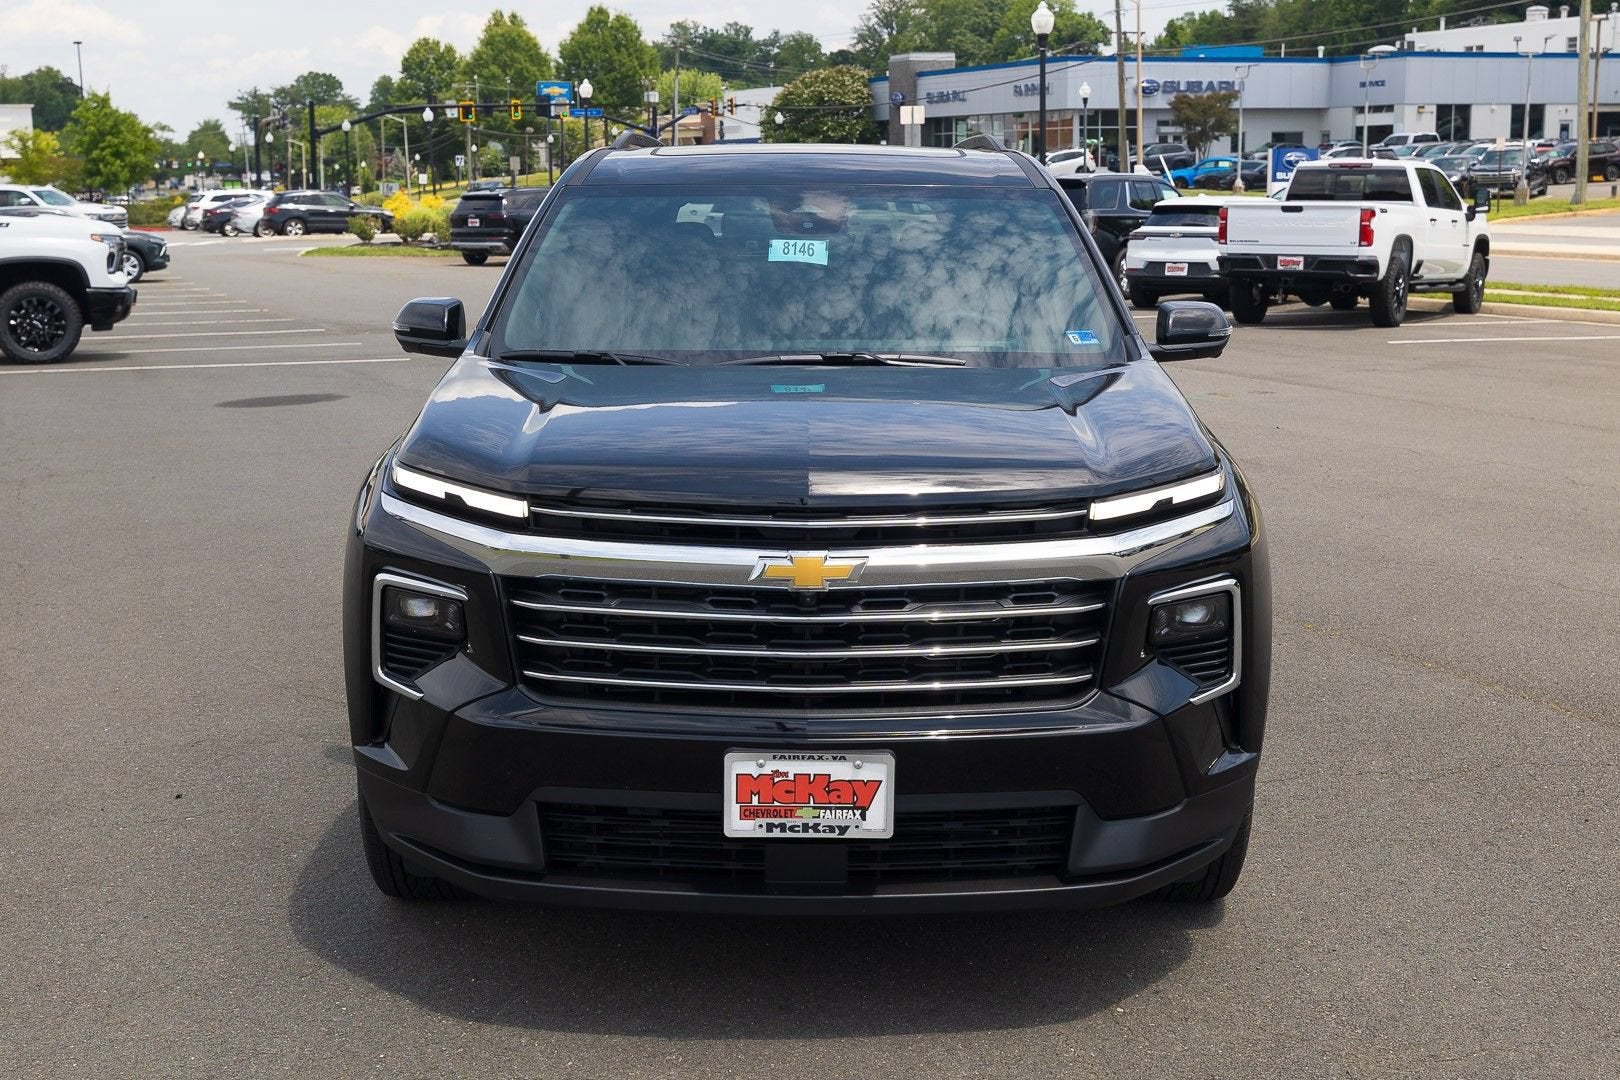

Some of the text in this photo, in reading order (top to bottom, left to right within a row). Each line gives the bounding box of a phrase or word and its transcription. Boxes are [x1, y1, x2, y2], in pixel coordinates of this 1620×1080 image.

[1162, 80, 1245, 94] SUBARU
[782, 241, 815, 257] 8146
[736, 773, 882, 811] McKay
[743, 808, 794, 819] CHEVROLET
[765, 822, 851, 836] McKay
